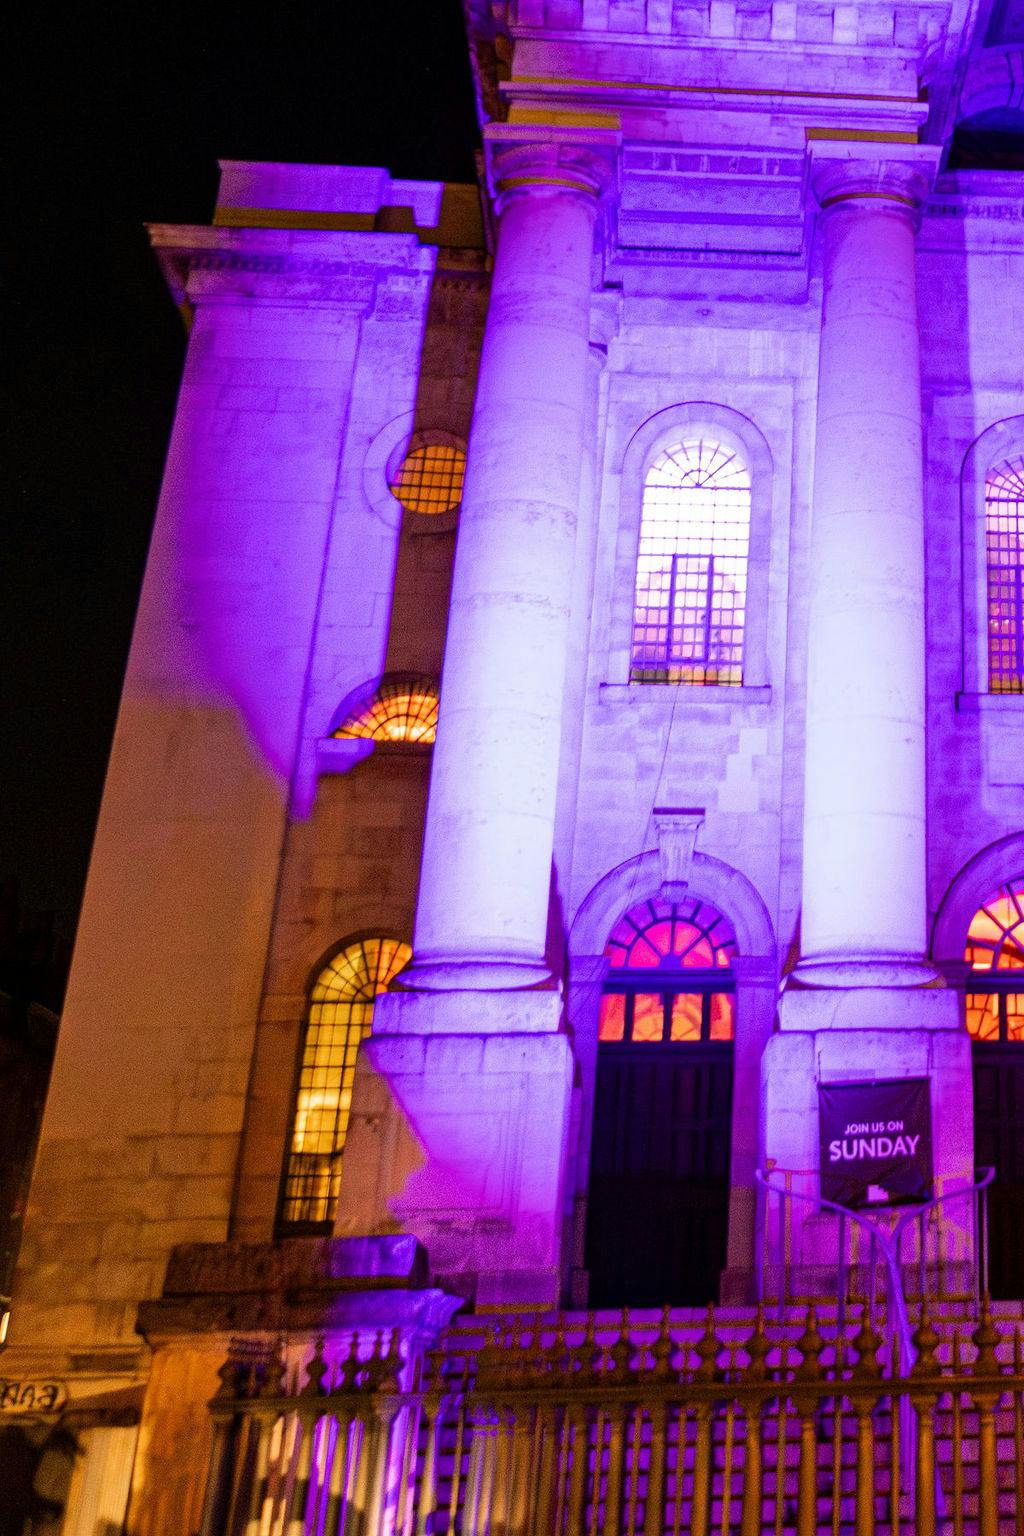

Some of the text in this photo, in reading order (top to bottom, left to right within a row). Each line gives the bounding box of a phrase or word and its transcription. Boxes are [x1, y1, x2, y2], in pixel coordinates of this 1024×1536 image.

[844, 1120, 903, 1135] JOIN US ON
[829, 1135, 920, 1161] SUNDAY
